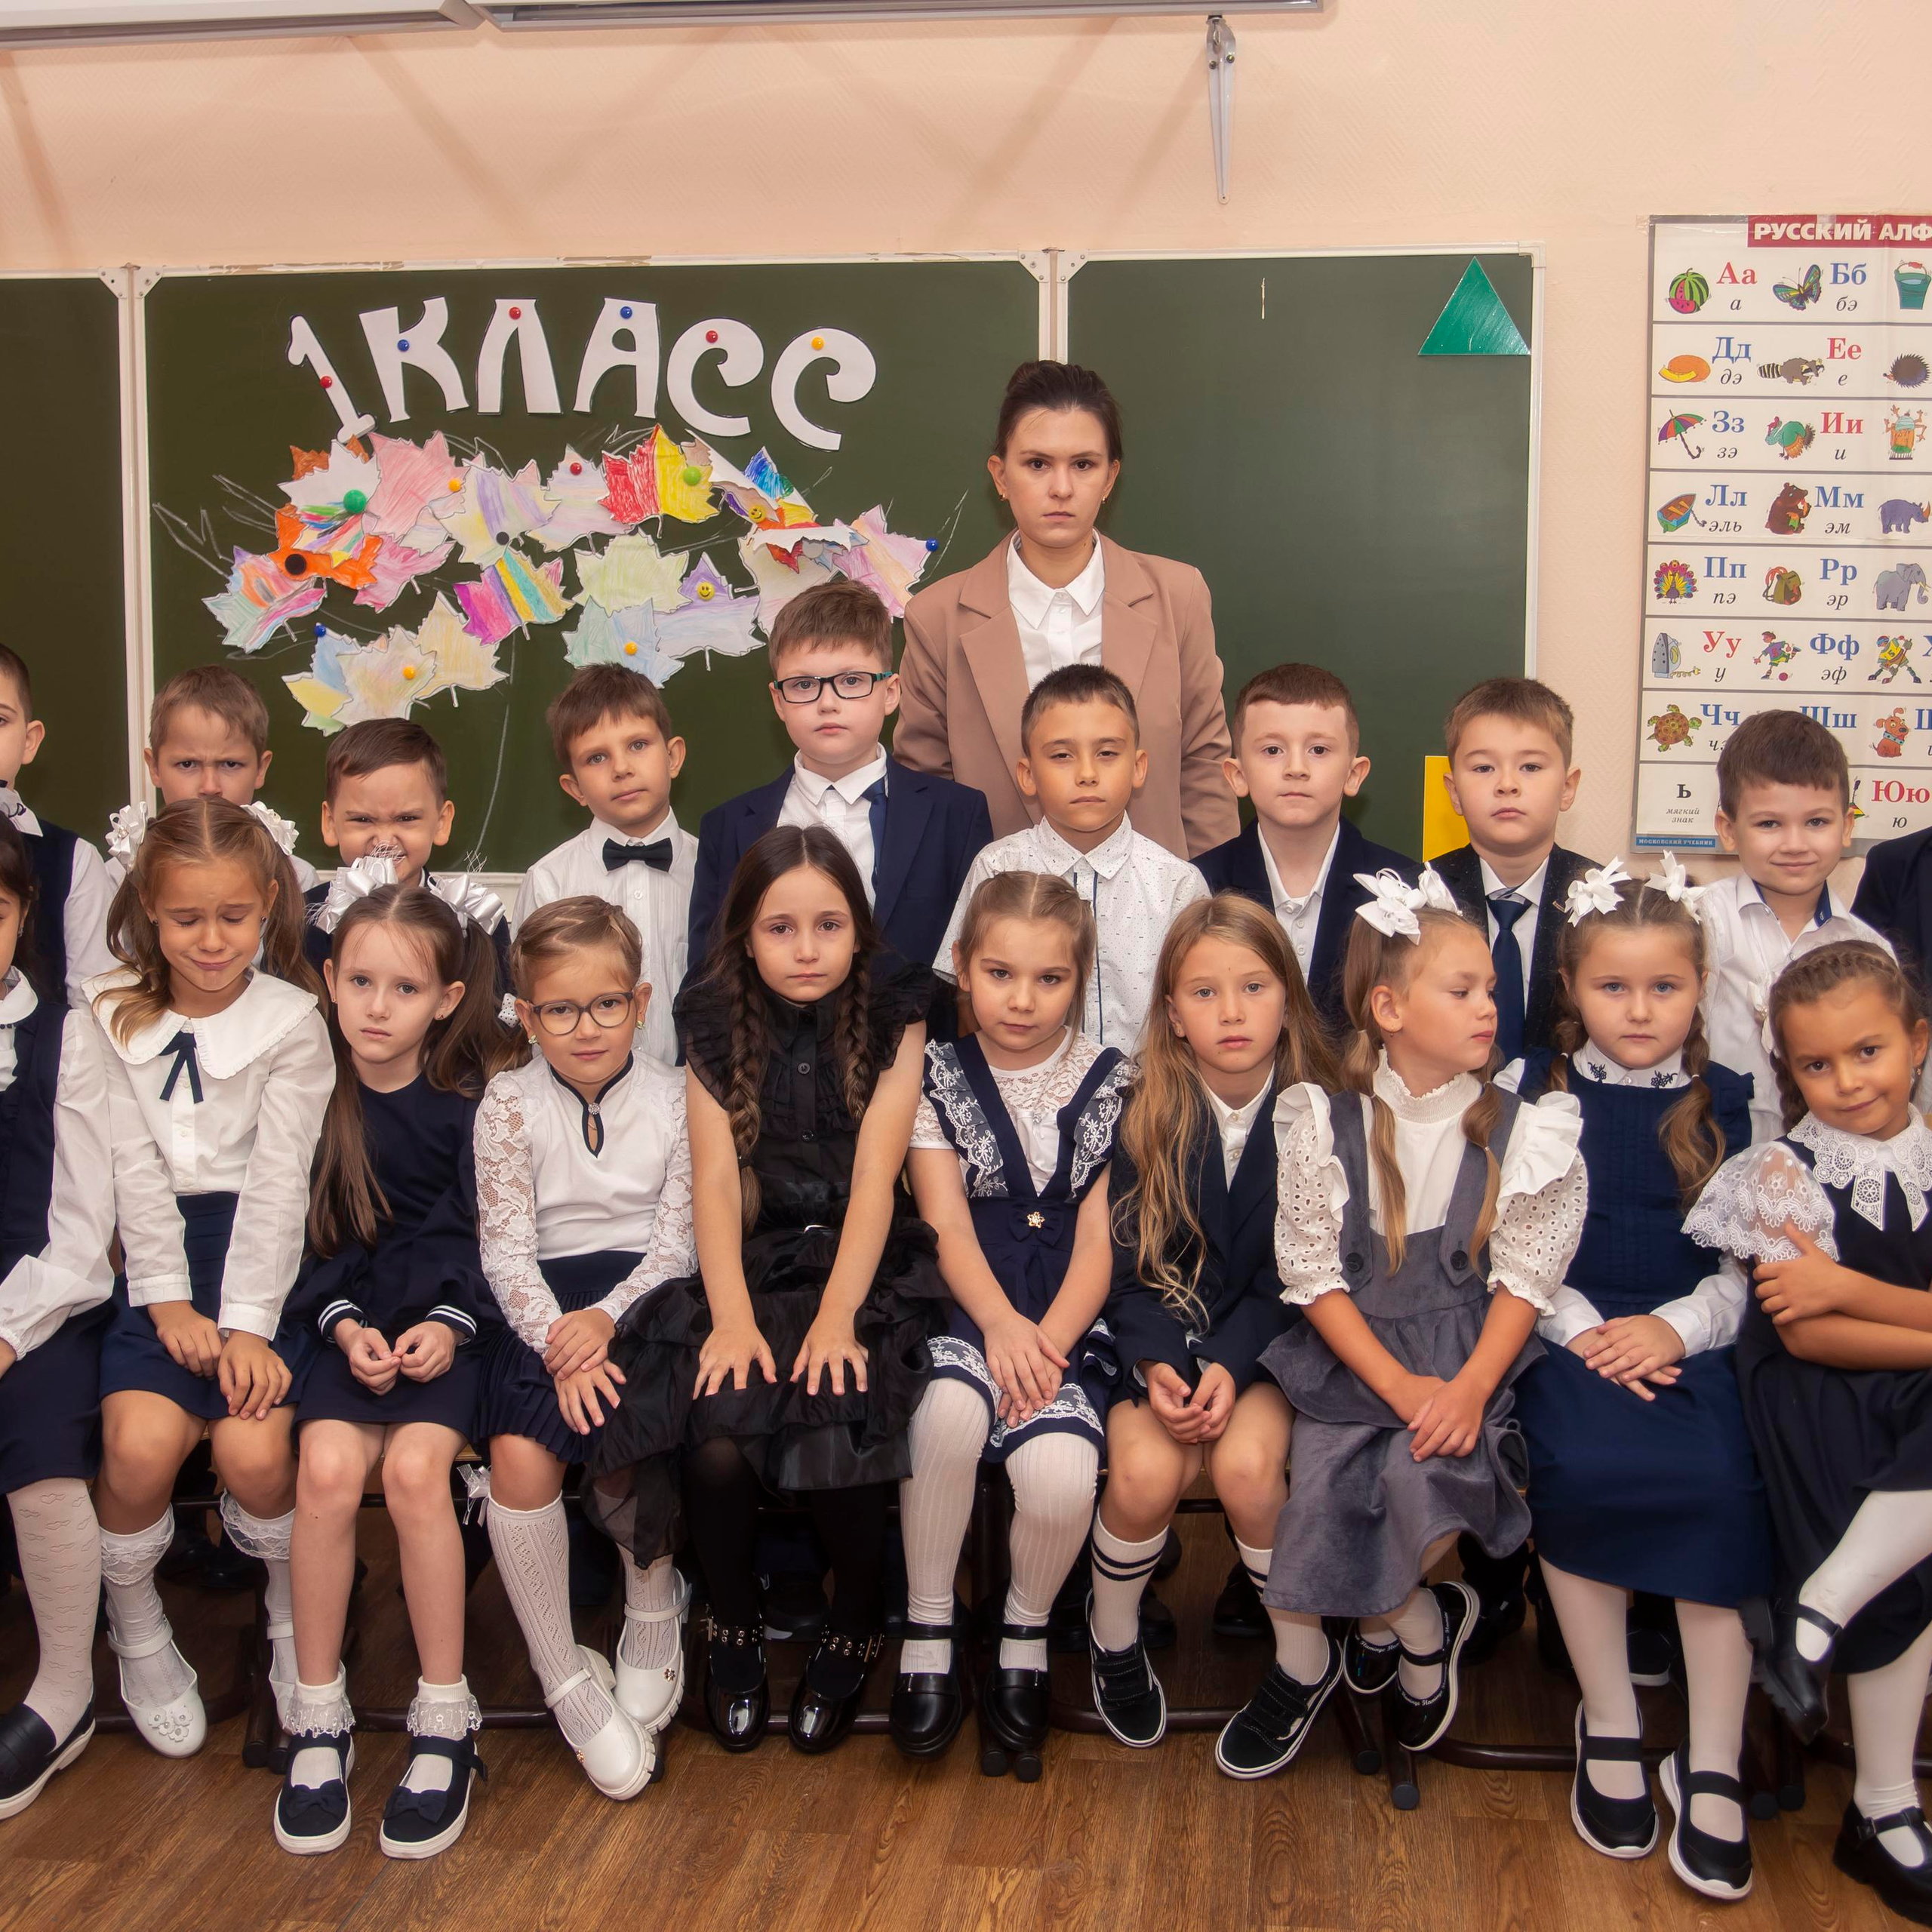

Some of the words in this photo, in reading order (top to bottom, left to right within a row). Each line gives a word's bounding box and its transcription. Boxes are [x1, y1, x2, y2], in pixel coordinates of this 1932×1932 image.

[1755, 220, 1871, 241] РУССКИЙ
[1878, 223, 1932, 242] АЛФ
[1716, 261, 1758, 285] Аа
[1829, 263, 1867, 285] Бб
[1730, 299, 1741, 311] а
[1836, 295, 1858, 312] бэ
[1712, 337, 1752, 364] Дд
[1826, 337, 1862, 360] Ее
[288, 315, 376, 442] 1
[358, 296, 876, 451] КЛАСС
[1720, 368, 1743, 385] дэ
[1838, 374, 1847, 386] е
[1712, 410, 1745, 433] Зз
[1820, 412, 1863, 434] Ии
[1717, 447, 1738, 459] зэ
[1835, 449, 1846, 460] и
[1705, 485, 1748, 507] Лл
[1814, 486, 1864, 509] Мм
[1709, 521, 1742, 533] эль
[1824, 522, 1850, 534] эм
[1703, 556, 1747, 579] Пп
[1820, 558, 1857, 586] Рр
[1713, 592, 1737, 605] пэ
[1826, 595, 1848, 611] эр
[1703, 630, 1742, 659] Уу
[1810, 632, 1860, 661] Фф
[1714, 667, 1726, 682] у
[1821, 666, 1847, 685] эф
[1700, 703, 1740, 726] Чч
[1676, 783, 1692, 798] ь
[1871, 780, 1930, 804] Юю
[1892, 817, 1907, 829] ю
